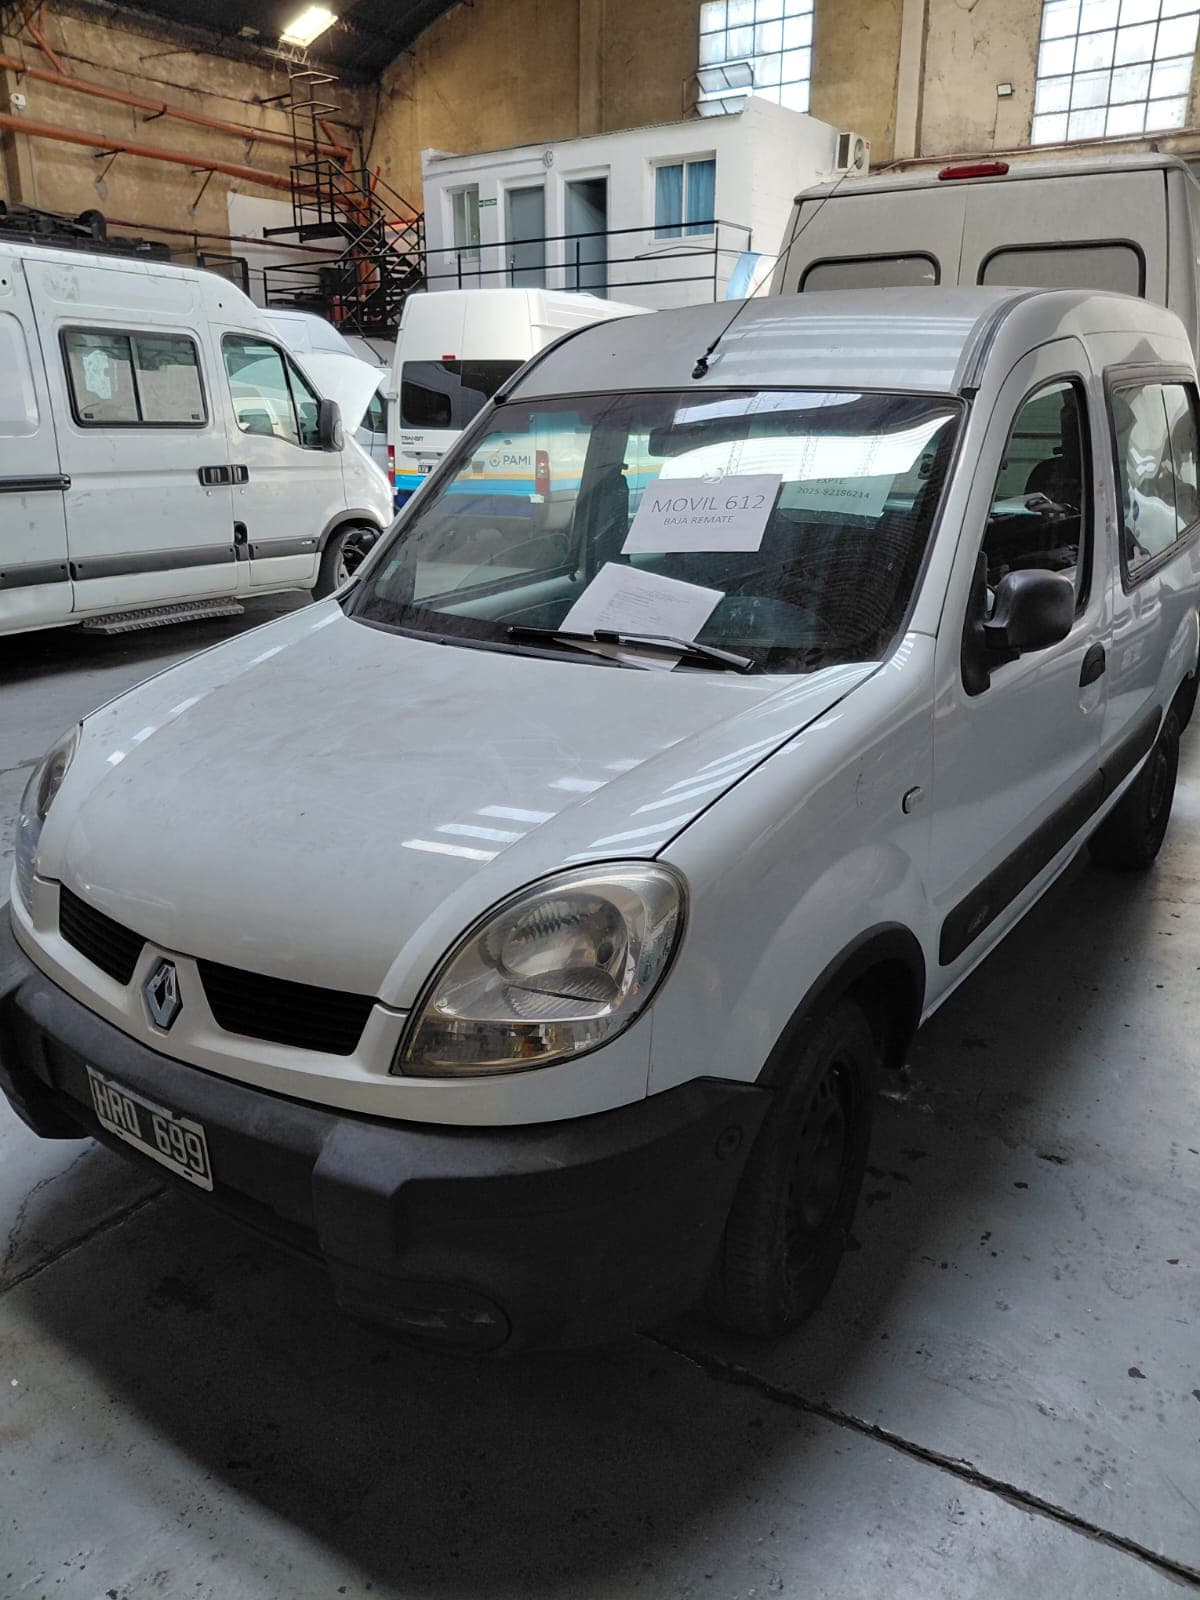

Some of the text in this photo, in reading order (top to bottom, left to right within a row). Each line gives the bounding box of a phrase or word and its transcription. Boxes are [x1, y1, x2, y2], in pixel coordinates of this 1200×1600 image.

[503, 455, 531, 465] PAMI
[651, 495, 765, 513] MOVIL 612
[663, 515, 735, 526] BAJA REMATE
[152, 1113, 205, 1174] 699
